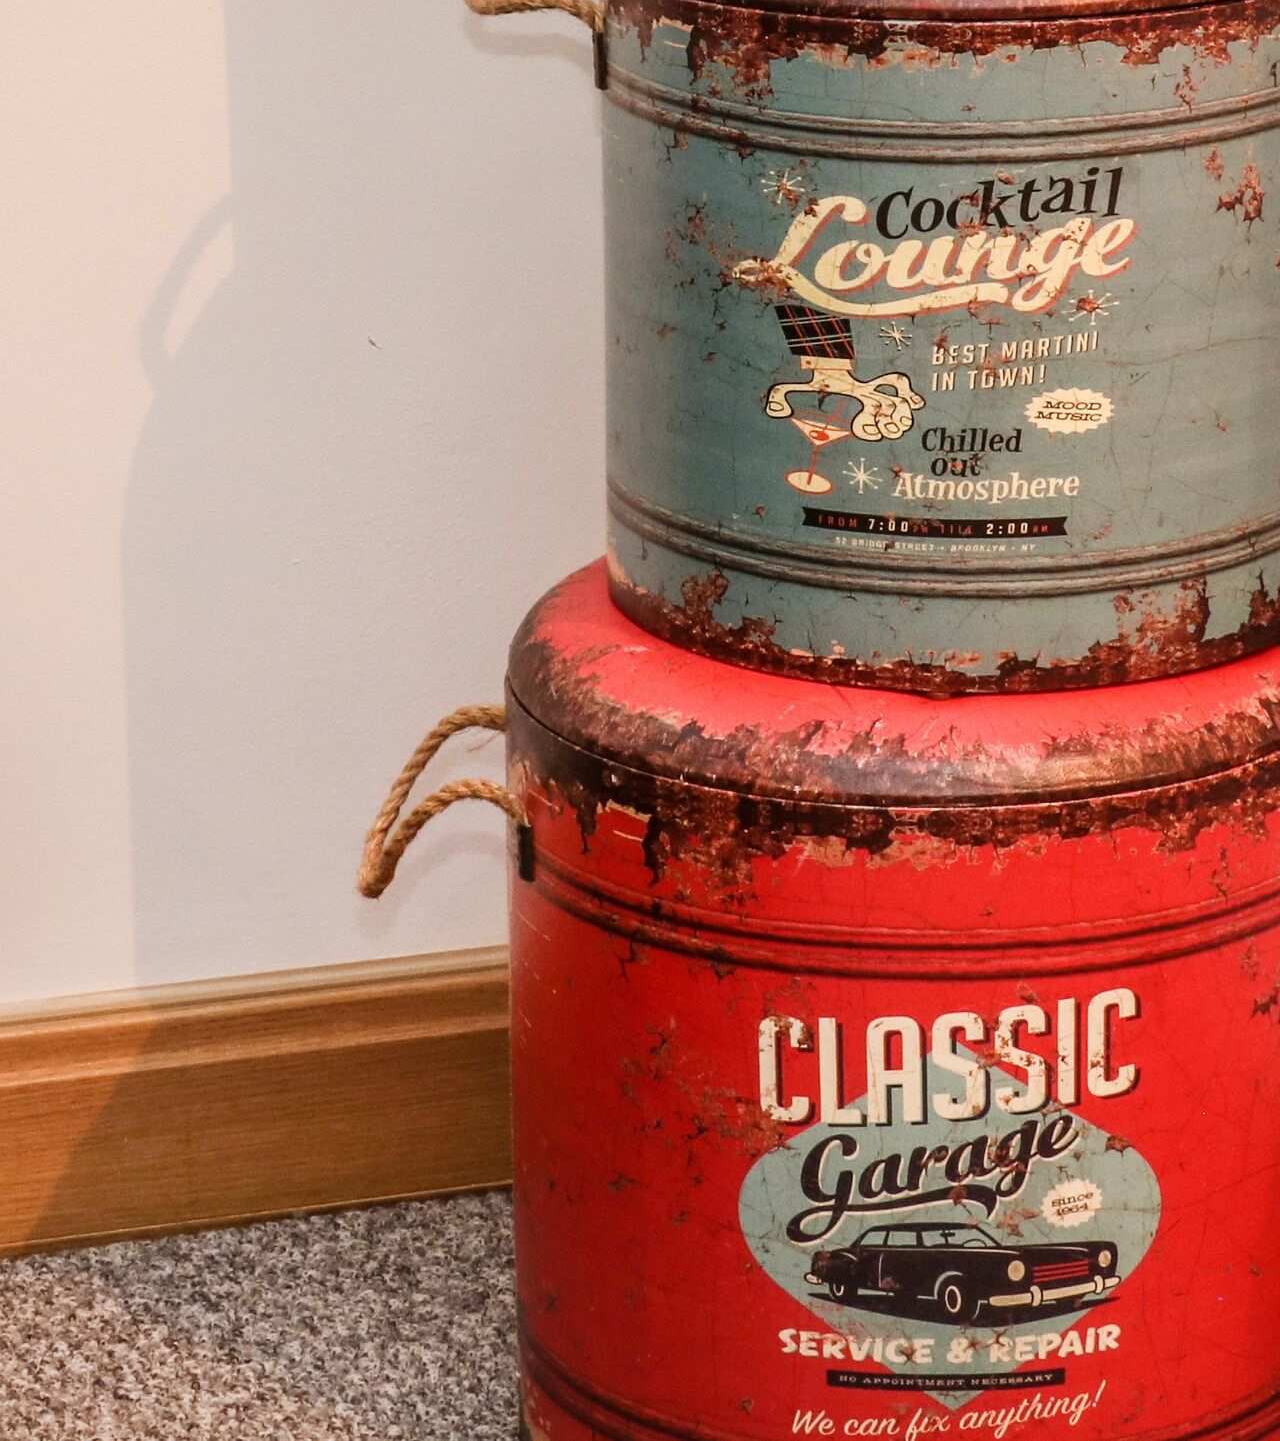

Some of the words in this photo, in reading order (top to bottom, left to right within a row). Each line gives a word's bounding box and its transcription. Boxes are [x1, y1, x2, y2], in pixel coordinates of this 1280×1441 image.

[875, 166, 1124, 240] Cocktail
[732, 195, 1139, 318] Lounge
[931, 343, 991, 366] BEST
[1001, 331, 1100, 361] MARTINI
[931, 372, 956, 392] IN
[967, 364, 1048, 391] TOWN!
[1035, 411, 1103, 422] MUSIC
[1042, 400, 1103, 411] MOOD
[921, 427, 1024, 453] Chilled
[930, 453, 983, 478] out
[891, 472, 1081, 505] Atmosphere
[950, 543, 1007, 553] BROOKLYN
[1021, 543, 1037, 552] NY
[757, 987, 1141, 1126] CLASSIC
[785, 1115, 1081, 1245] Garage
[777, 1328, 936, 1364] SERVICE
[947, 1337, 975, 1364] &
[988, 1323, 1122, 1362] REPAIR
[839, 1375, 857, 1383] NO
[863, 1377, 966, 1387] APPOINTMENT
[971, 1374, 1054, 1385] NECESSARY
[792, 1409, 835, 1436] We
[843, 1416, 900, 1436] can
[905, 1407, 951, 1441] fix
[959, 1379, 1107, 1440] anything!
